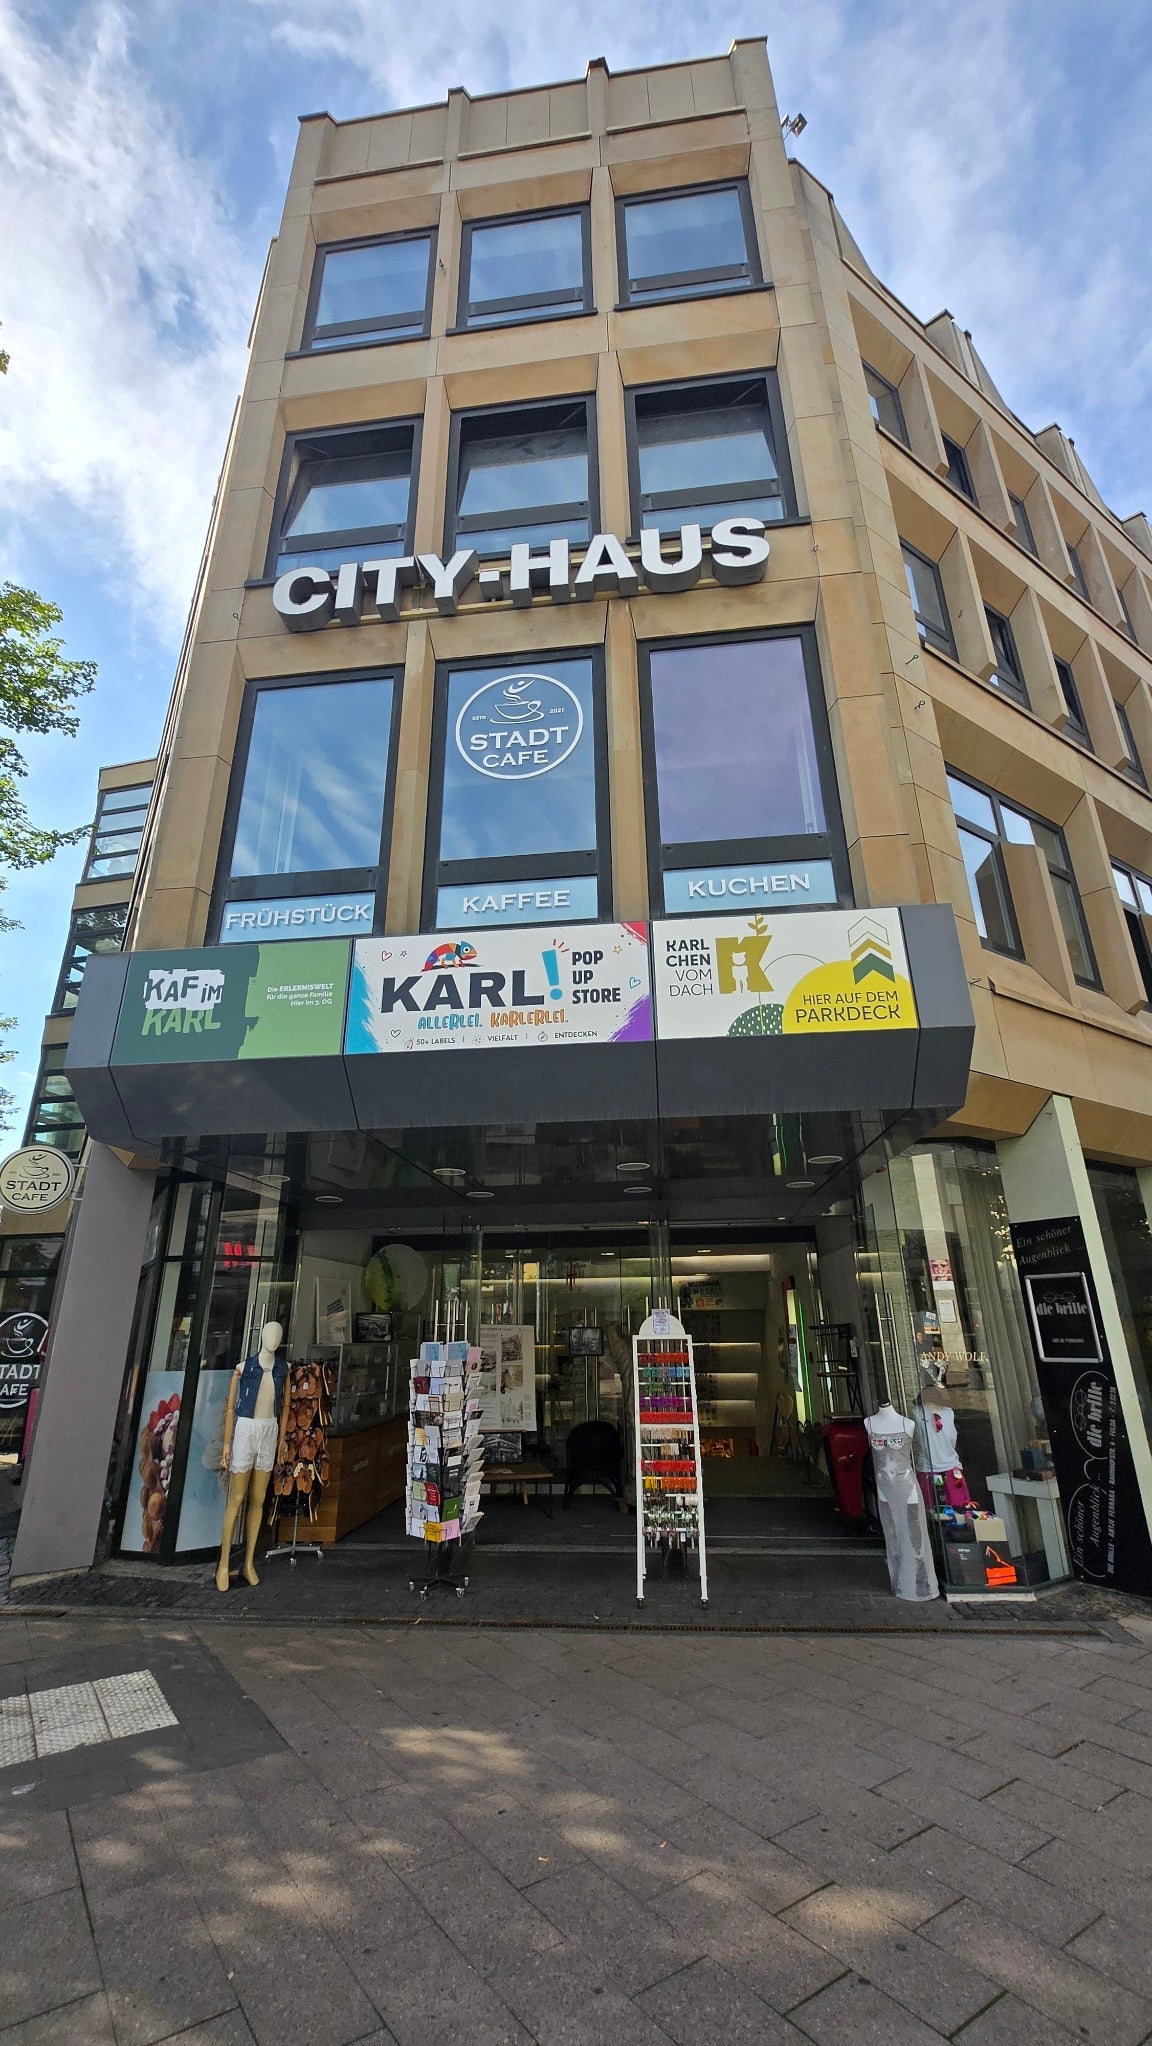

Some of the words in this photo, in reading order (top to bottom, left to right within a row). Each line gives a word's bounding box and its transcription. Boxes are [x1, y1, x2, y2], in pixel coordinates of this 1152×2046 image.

[469, 726, 569, 751] STADT
[482, 749, 549, 768] CAFE
[687, 872, 811, 898] KUCHEN
[462, 889, 571, 912] KAFFEE
[225, 903, 371, 930] FRÜHSTÜCK
[665, 938, 710, 952] KARL
[572, 950, 604, 966] POP
[665, 953, 711, 967] CHEN
[572, 969, 594, 985] UP
[675, 968, 712, 982] VOM
[146, 976, 200, 1003] KAF
[279, 983, 334, 992] ERLEBNISWELT
[572, 987, 621, 1004] STORE
[669, 983, 714, 997] DACH
[288, 993, 309, 1001] ganze
[803, 993, 831, 1006] HIER
[835, 992, 862, 1004] AUF
[866, 990, 899, 1003] DEM
[141, 1008, 221, 1036] KARL
[795, 1004, 901, 1023] PARKDECK
[416, 1038, 429, 1046] 50+
[431, 1037, 456, 1045] LABELS
[487, 1034, 518, 1042] VIELFALT
[554, 1030, 598, 1039] ENTDECKEN
[6, 1180, 62, 1192] STADT
[11, 1192, 49, 1201] CAFE
[1016, 1237, 1033, 1249] Ein
[1035, 1224, 1073, 1244] schöner
[1019, 1243, 1072, 1265] Augenblick
[1036, 1301, 1054, 1316] die
[1054, 1301, 1088, 1316] brille
[921, 1351, 952, 1362] ANDY
[0, 1363, 41, 1380] TADT
[0, 1383, 29, 1396] AFE
[1086, 1381, 1103, 1424] brille
[1086, 1424, 1103, 1448] die
[1074, 1499, 1086, 1545] schöner
[1089, 1485, 1101, 1548] Augenblick
[1073, 1546, 1084, 1567] Ein
